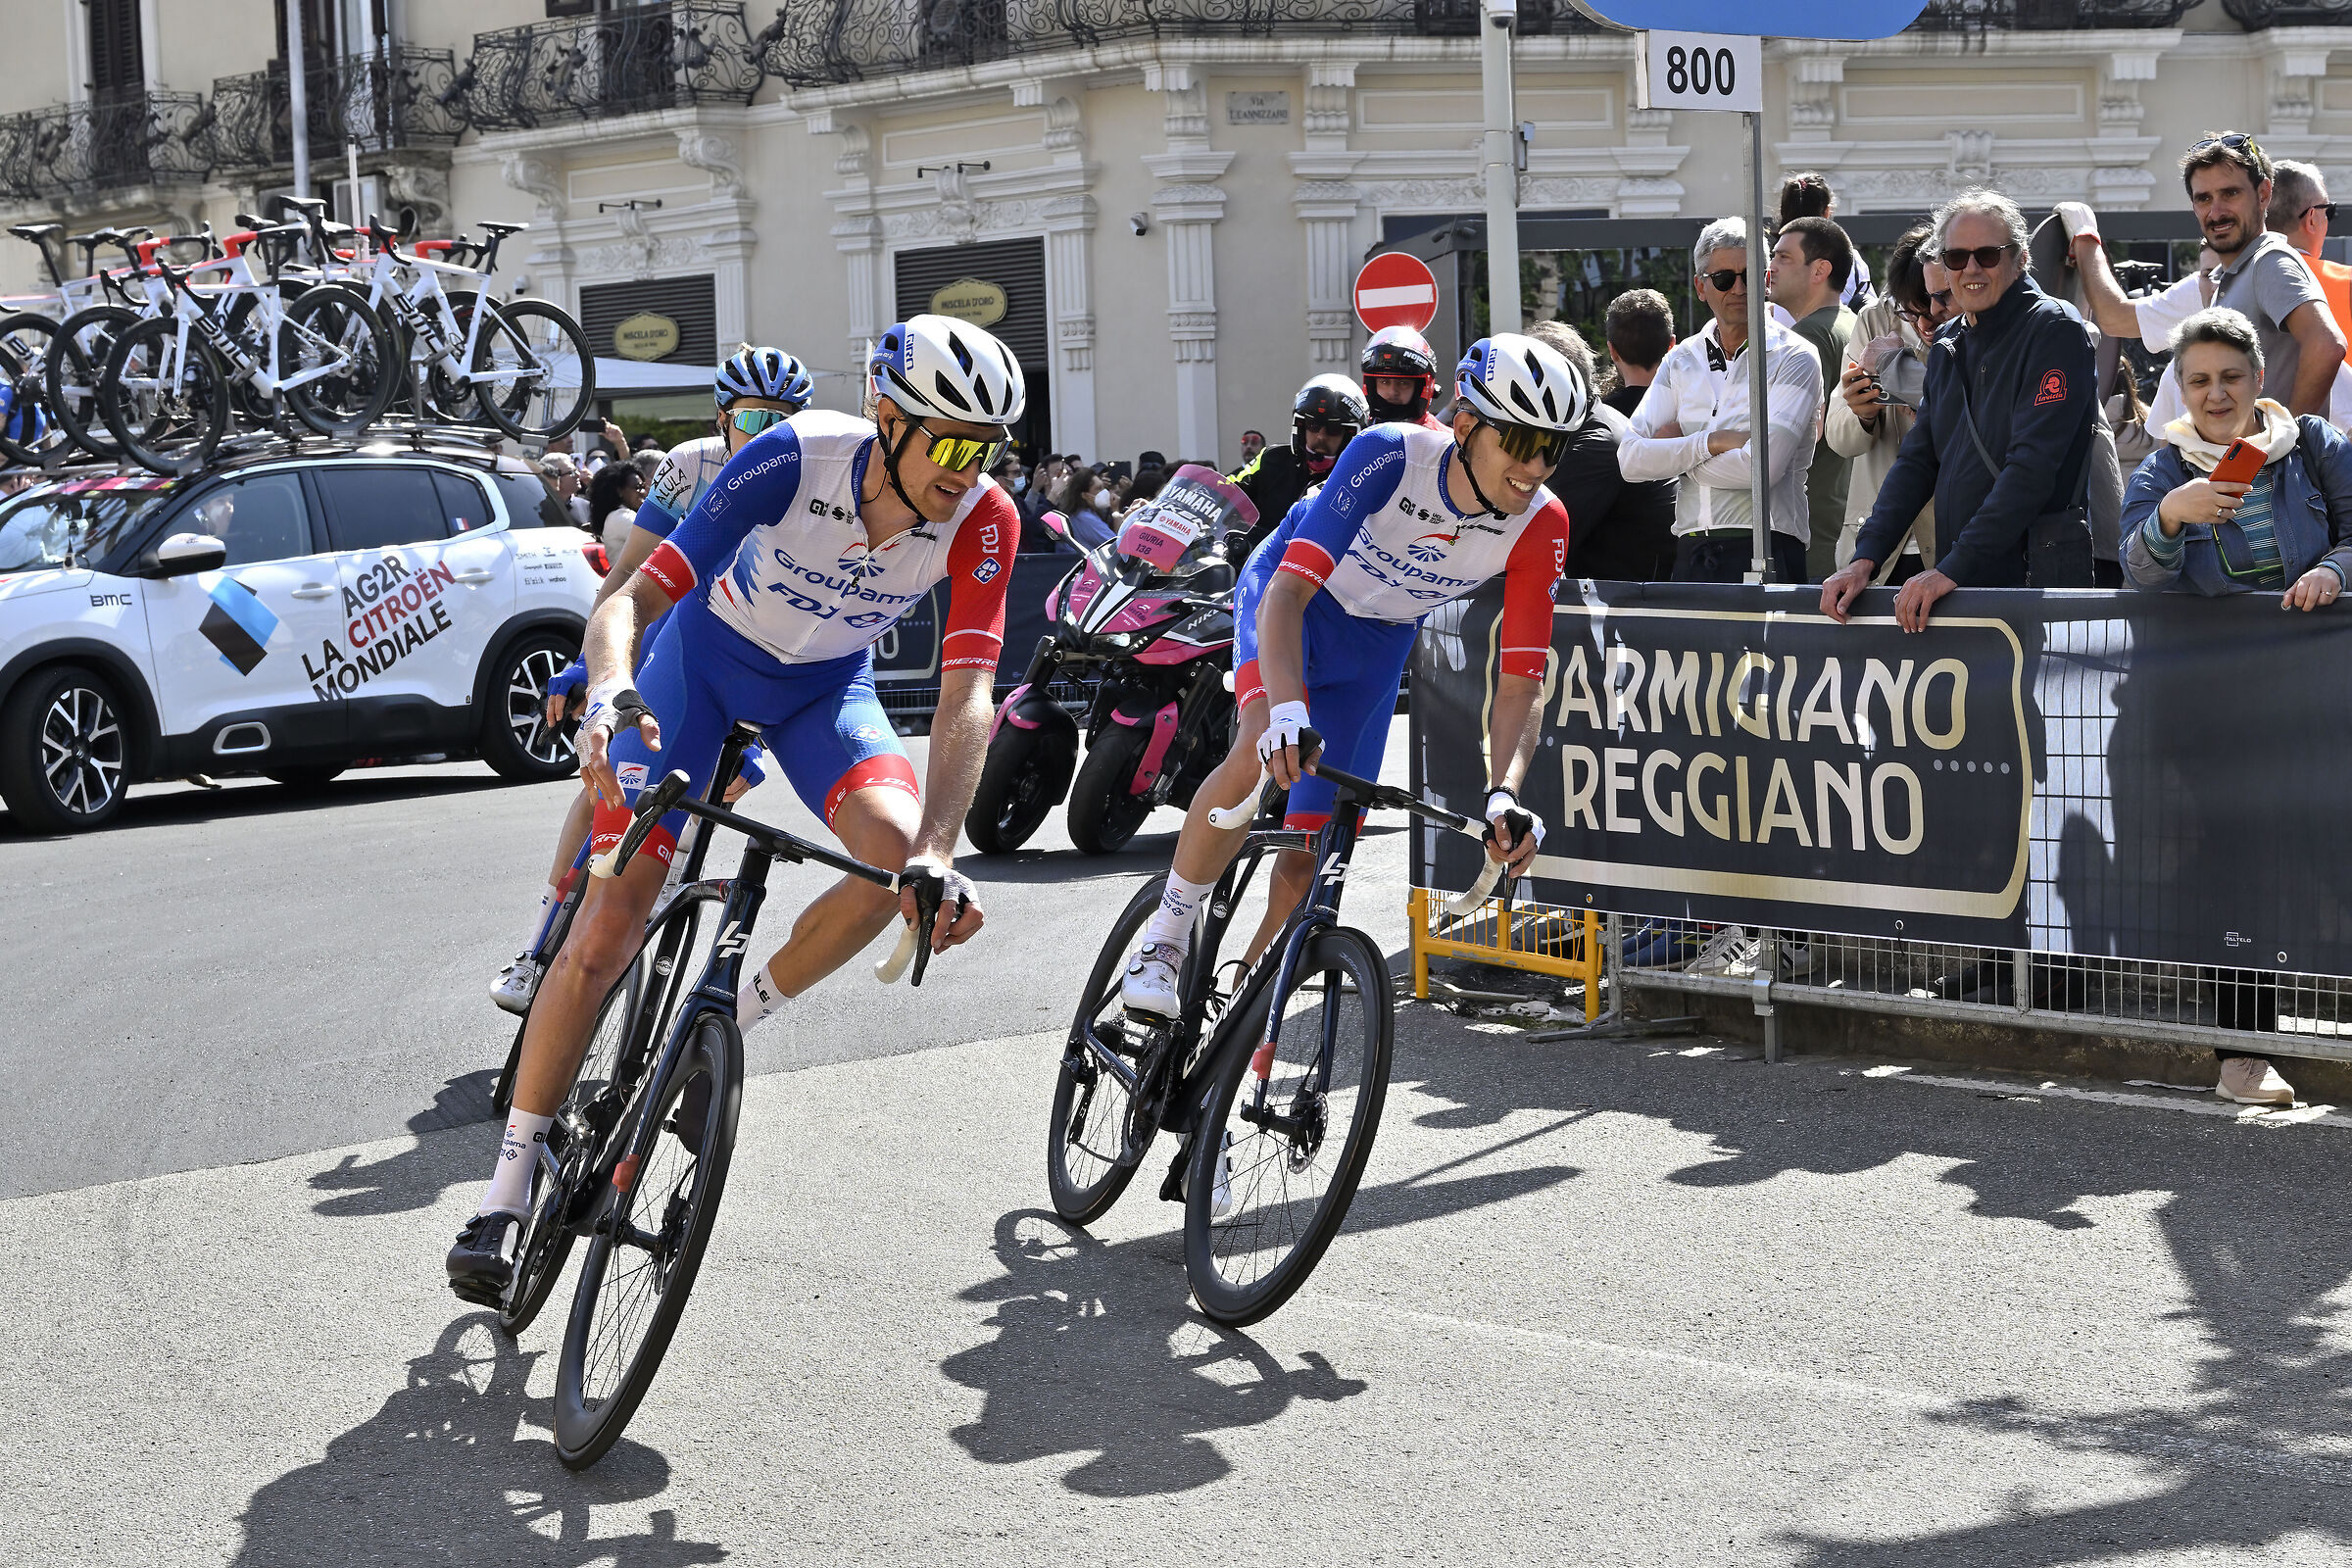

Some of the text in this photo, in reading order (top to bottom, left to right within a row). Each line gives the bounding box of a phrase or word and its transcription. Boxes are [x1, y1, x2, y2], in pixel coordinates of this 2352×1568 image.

[1667, 46, 1736, 95] 800
[1250, 96, 1264, 106] VIA
[941, 297, 995, 309] MISCELA D'ORO
[393, 292, 439, 353] BMC
[198, 316, 249, 370] BMC
[906, 333, 915, 371] GIRO
[1487, 348, 1498, 382] GIRO
[656, 468, 687, 505] ALULA
[727, 451, 799, 491] Groupama
[1350, 449, 1405, 488] Groupama
[1168, 486, 1223, 522] YAMAHA
[980, 523, 1000, 554] FDJ
[1139, 532, 1164, 548] GIURIA
[1165, 517, 1192, 536] YAMAHA
[1136, 543, 1152, 555] 138
[1347, 549, 1403, 587] FDJ
[1358, 526, 1480, 587] Groupama
[1551, 538, 1565, 572] FDJ
[342, 555, 411, 618] AG2R
[774, 548, 921, 605] Groupama
[90, 594, 132, 607] BMC
[347, 560, 456, 649] CITROËN
[767, 582, 842, 620] FDJ
[301, 639, 344, 682] LA
[313, 600, 453, 703] MONDIALE
[1561, 744, 1924, 856] REGGIANO
